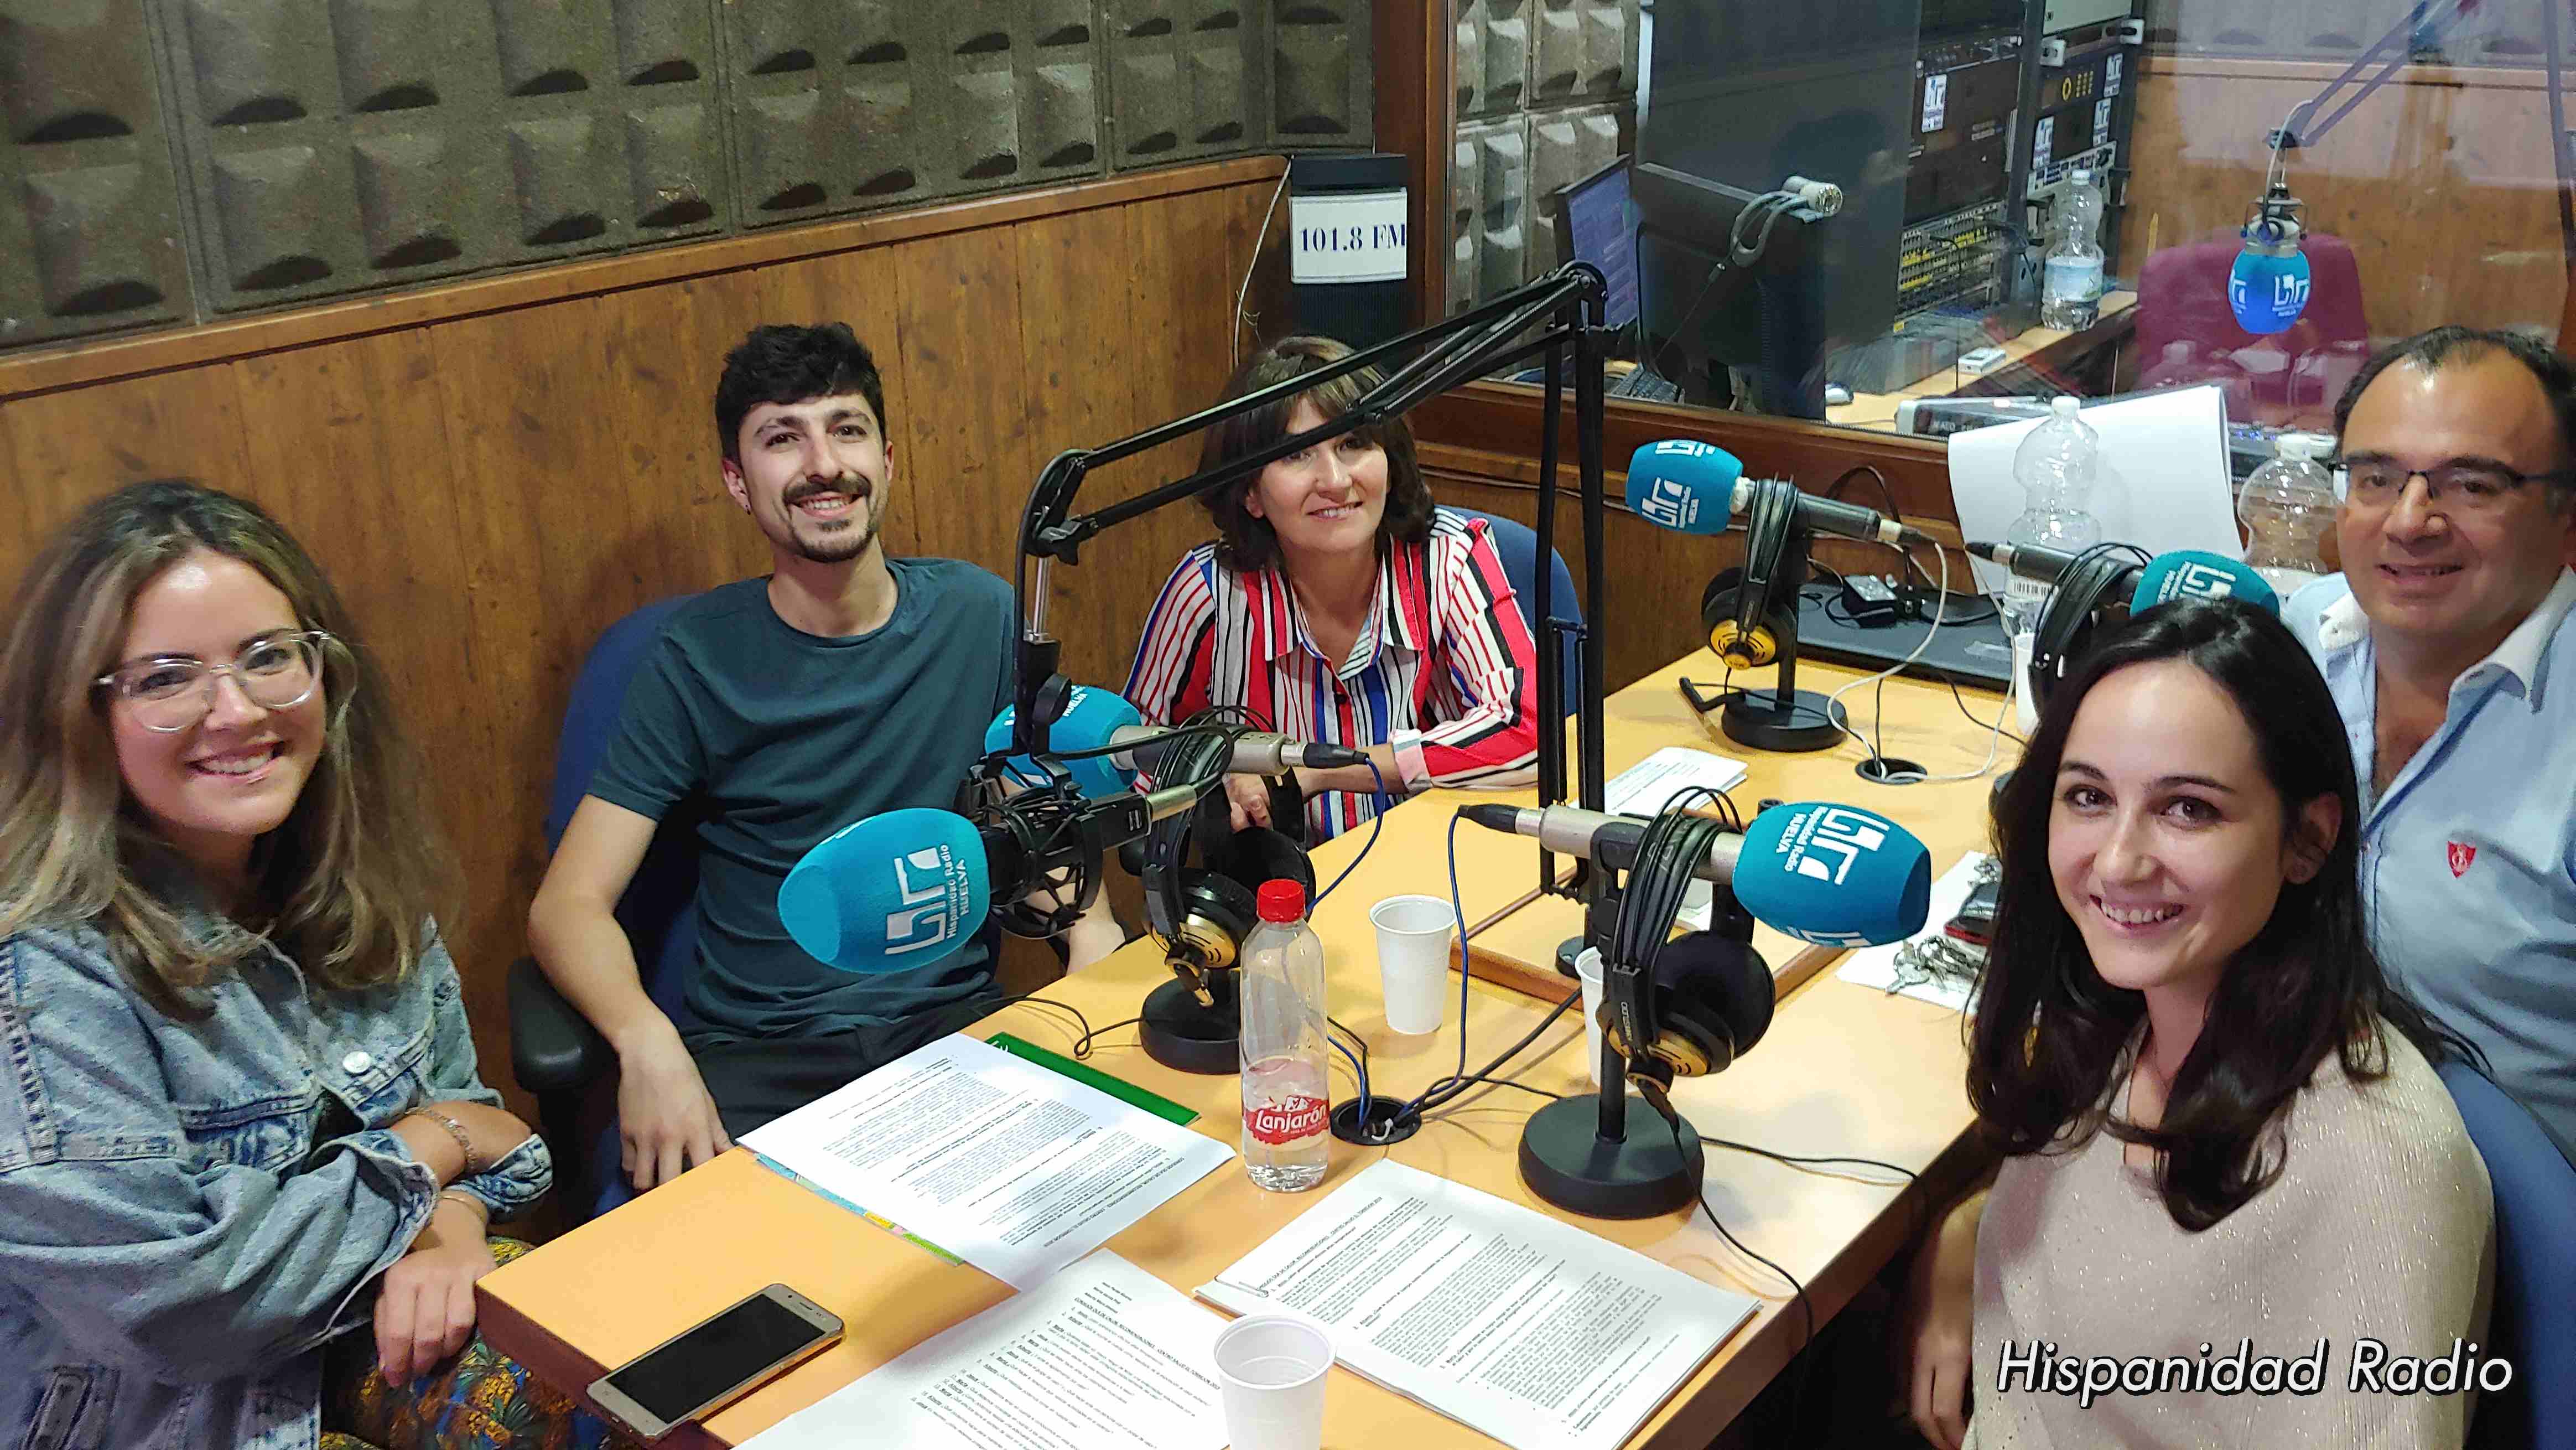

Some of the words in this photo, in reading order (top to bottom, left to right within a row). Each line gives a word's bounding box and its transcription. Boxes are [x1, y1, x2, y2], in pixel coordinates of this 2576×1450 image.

[1300, 226, 1363, 252] 101.8
[1373, 223, 1406, 249] FM
[1775, 812, 1806, 854] HUELVA
[941, 845, 954, 876] Radio
[956, 859, 969, 916] HUELVA
[1254, 1104, 1327, 1134] Lanjarón
